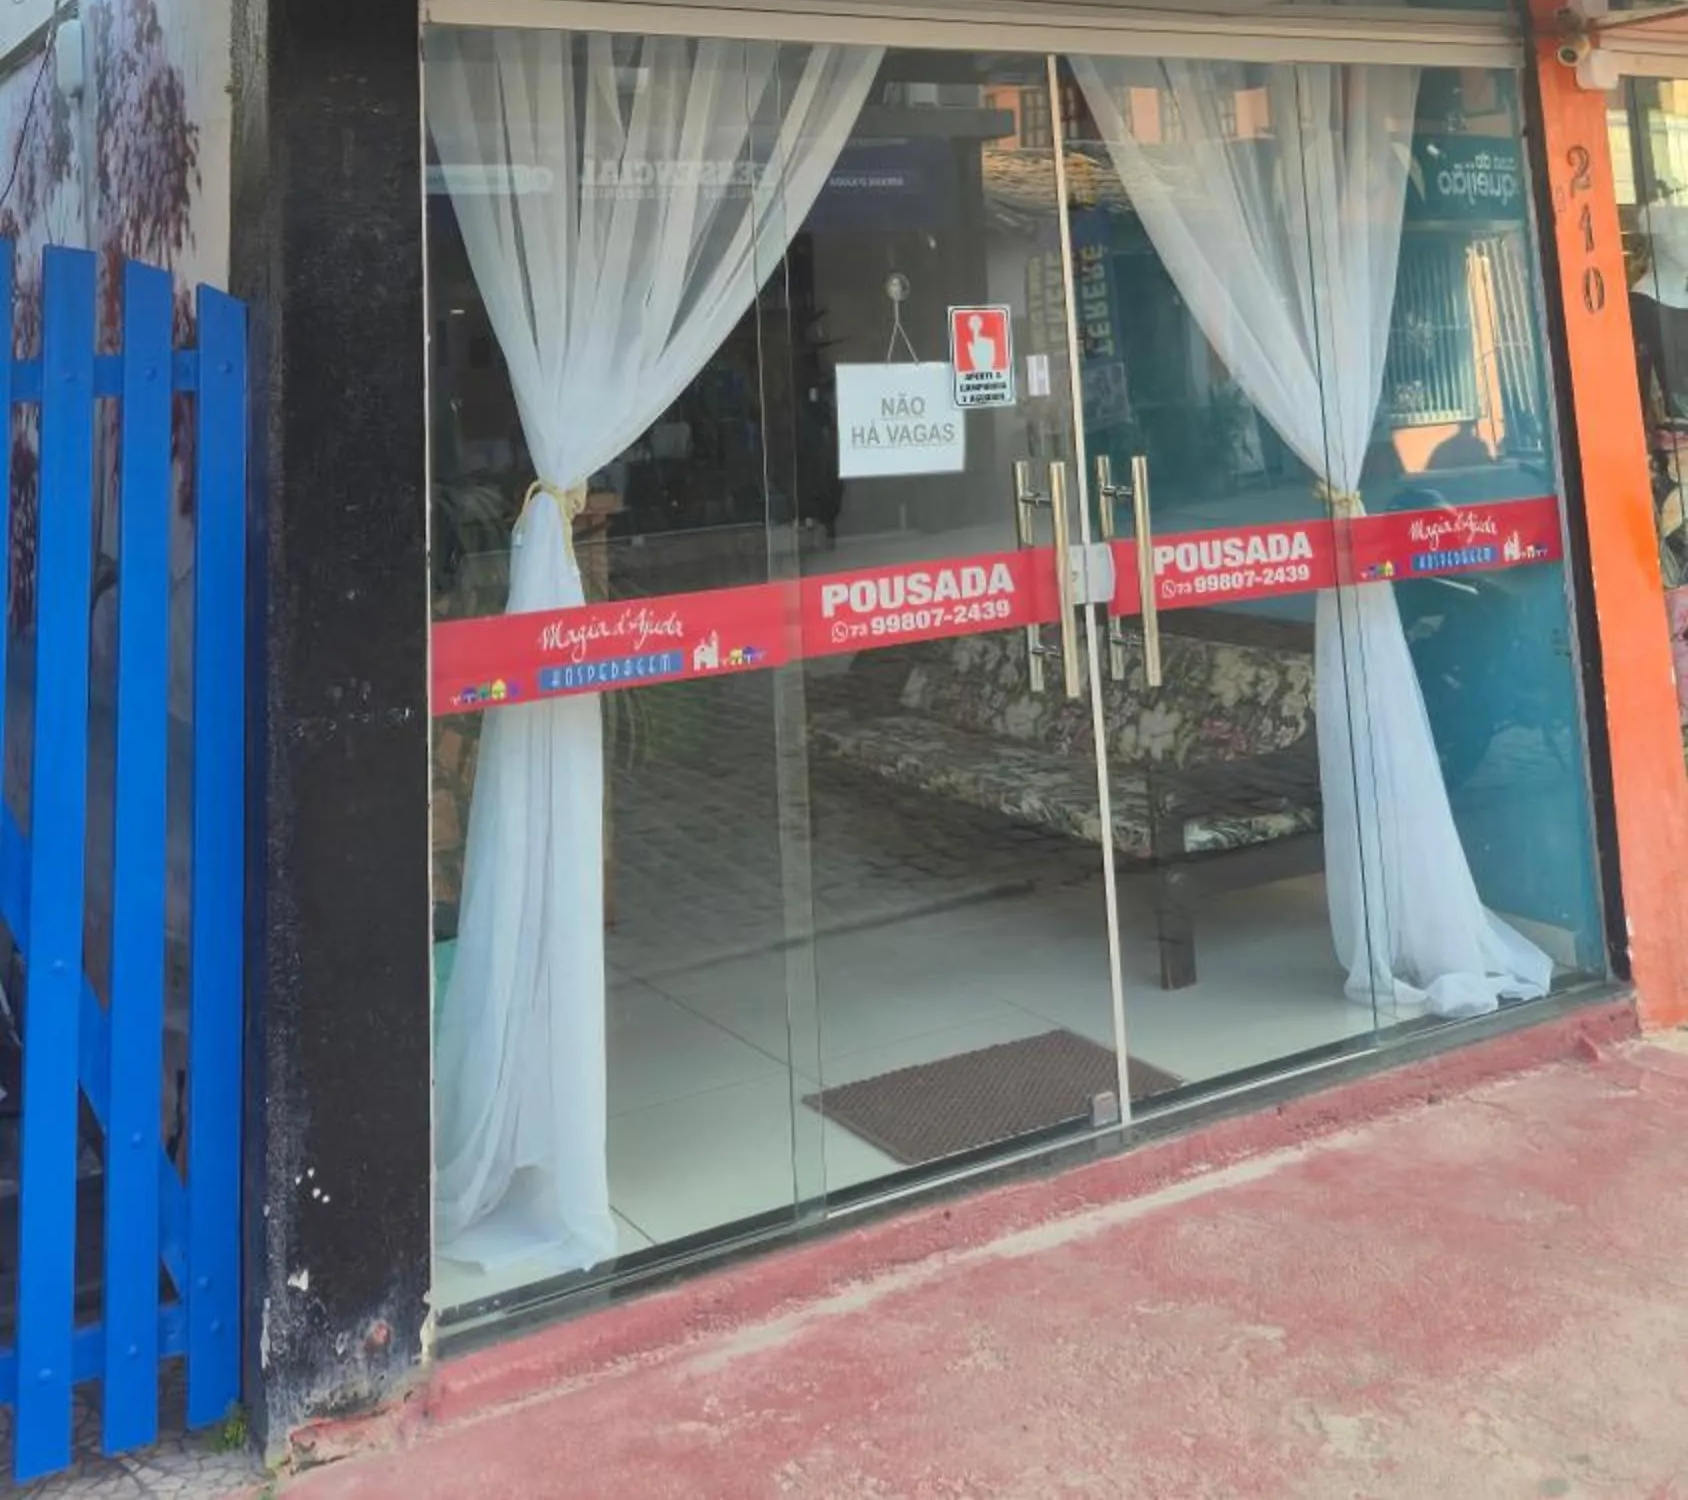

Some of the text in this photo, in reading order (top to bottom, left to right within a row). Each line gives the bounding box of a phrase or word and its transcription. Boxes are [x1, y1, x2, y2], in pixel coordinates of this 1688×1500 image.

[881, 393, 926, 417] NÃO
[886, 422, 955, 443] VAGAS
[1153, 531, 1313, 575] POUSADA
[821, 563, 1015, 618] POUSADA
[1194, 564, 1310, 594] 99807-2439
[871, 599, 1012, 636] 99807-2439
